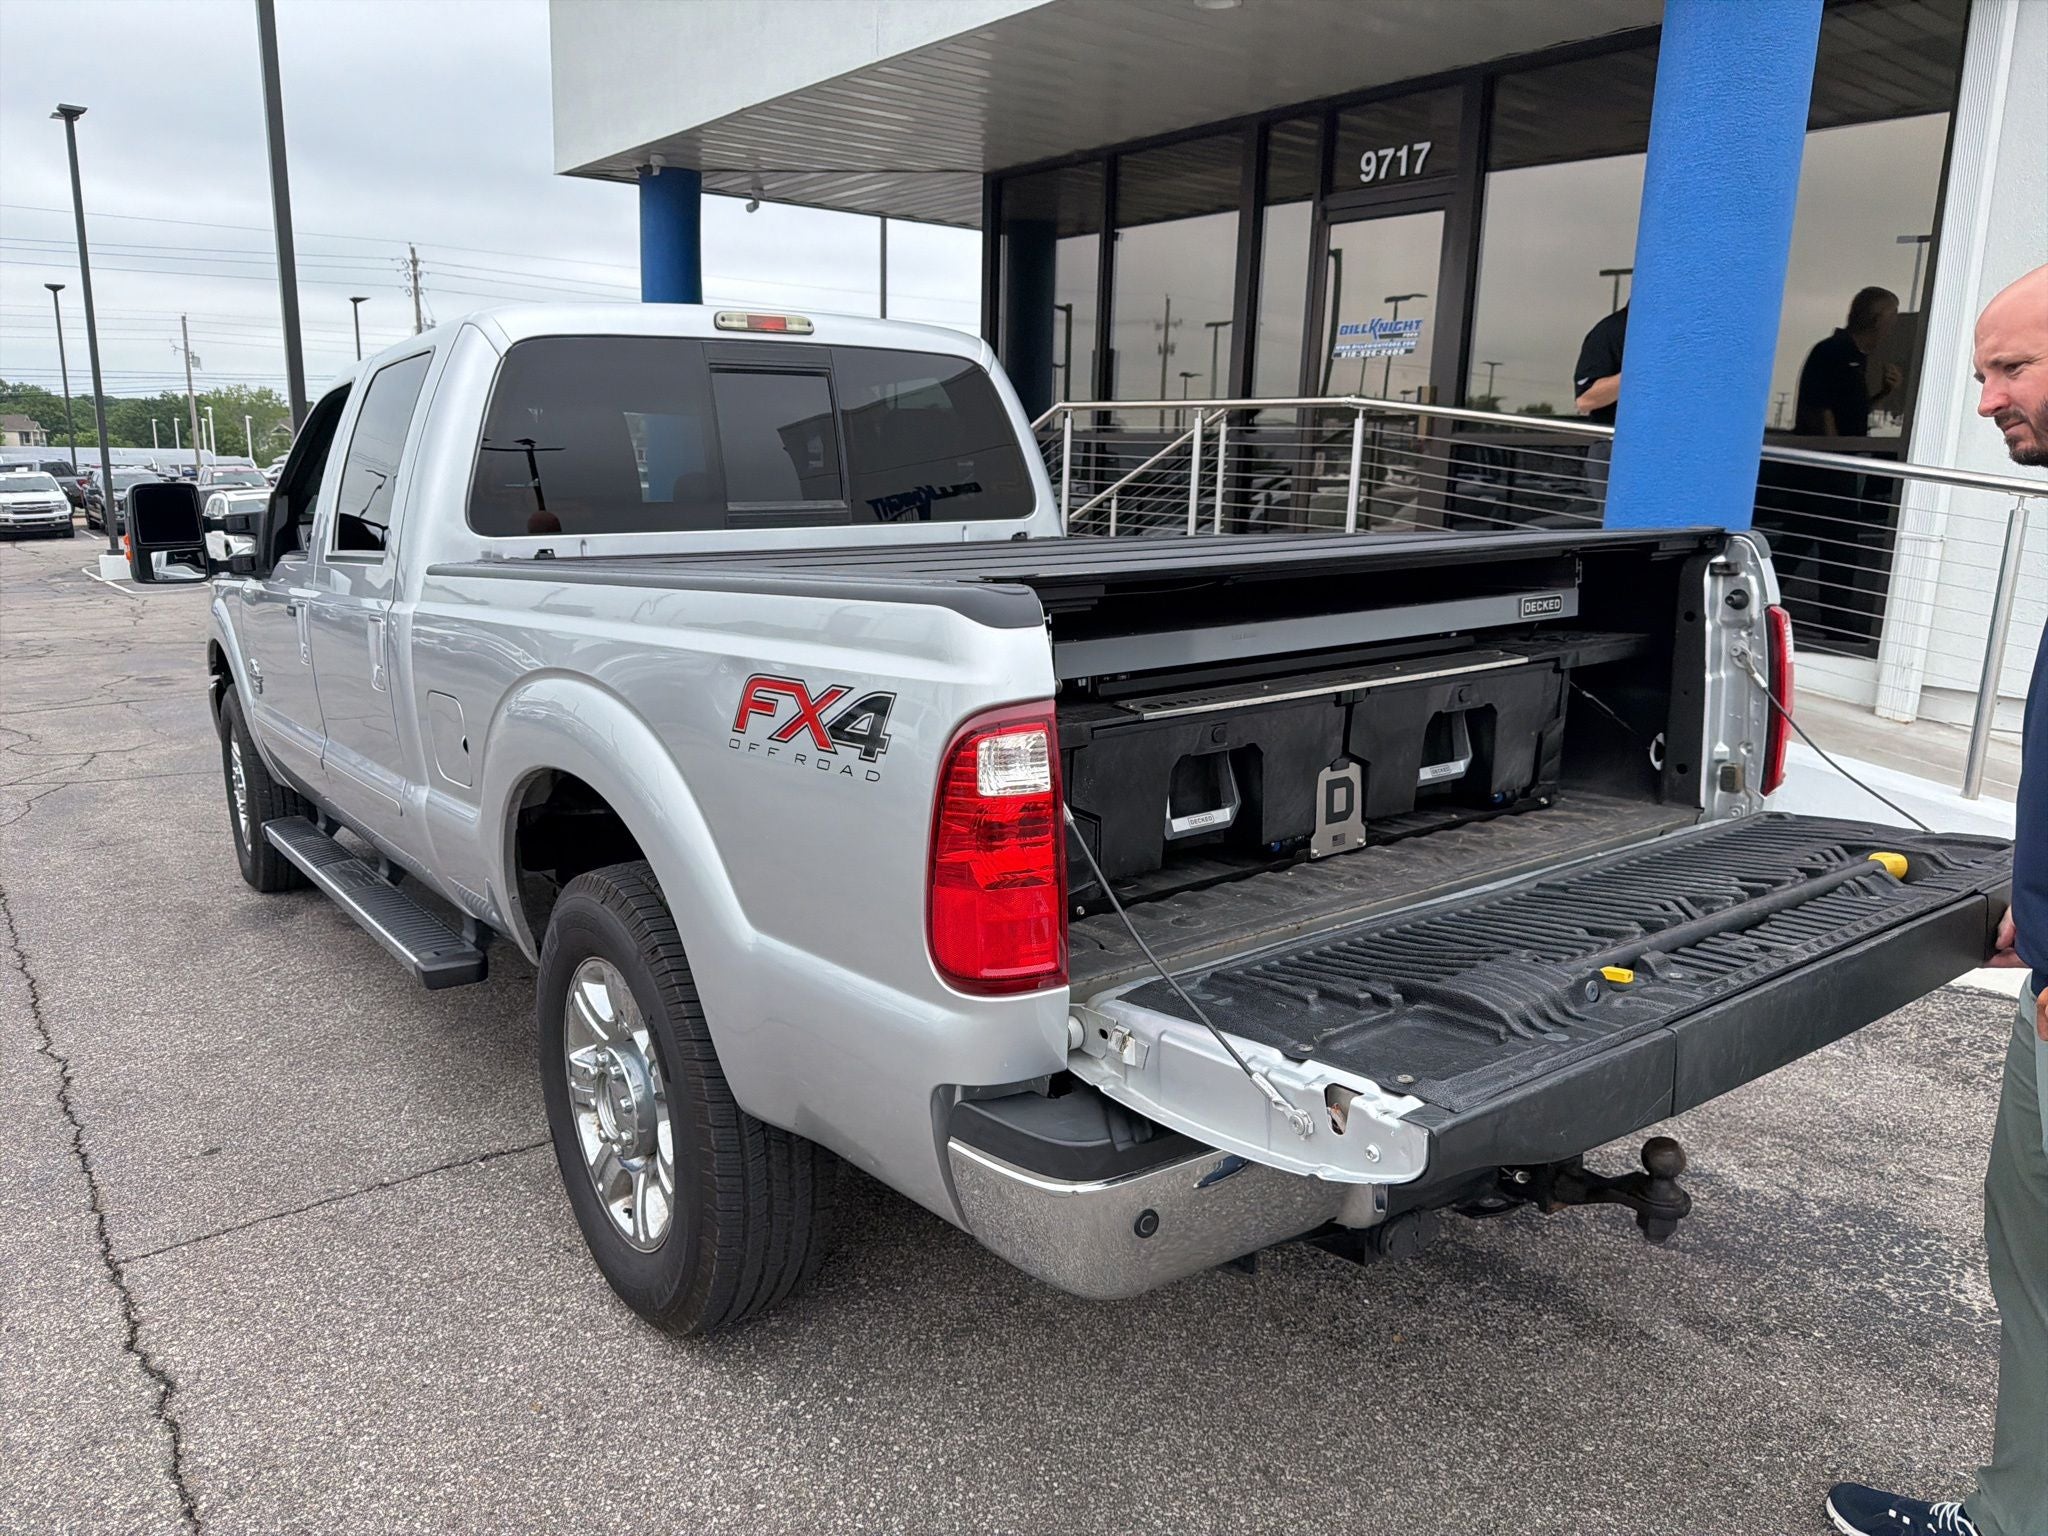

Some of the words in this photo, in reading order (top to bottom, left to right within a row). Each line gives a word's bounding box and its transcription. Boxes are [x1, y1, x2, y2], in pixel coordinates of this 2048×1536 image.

[1360, 141, 1431, 182] 9717
[1525, 599, 1560, 613] DECKED
[732, 673, 897, 763] FX4
[728, 738, 780, 757] OFF
[795, 753, 881, 782] ROAD
[1190, 815, 1213, 825] DECKED
[1326, 776, 1354, 825] D
